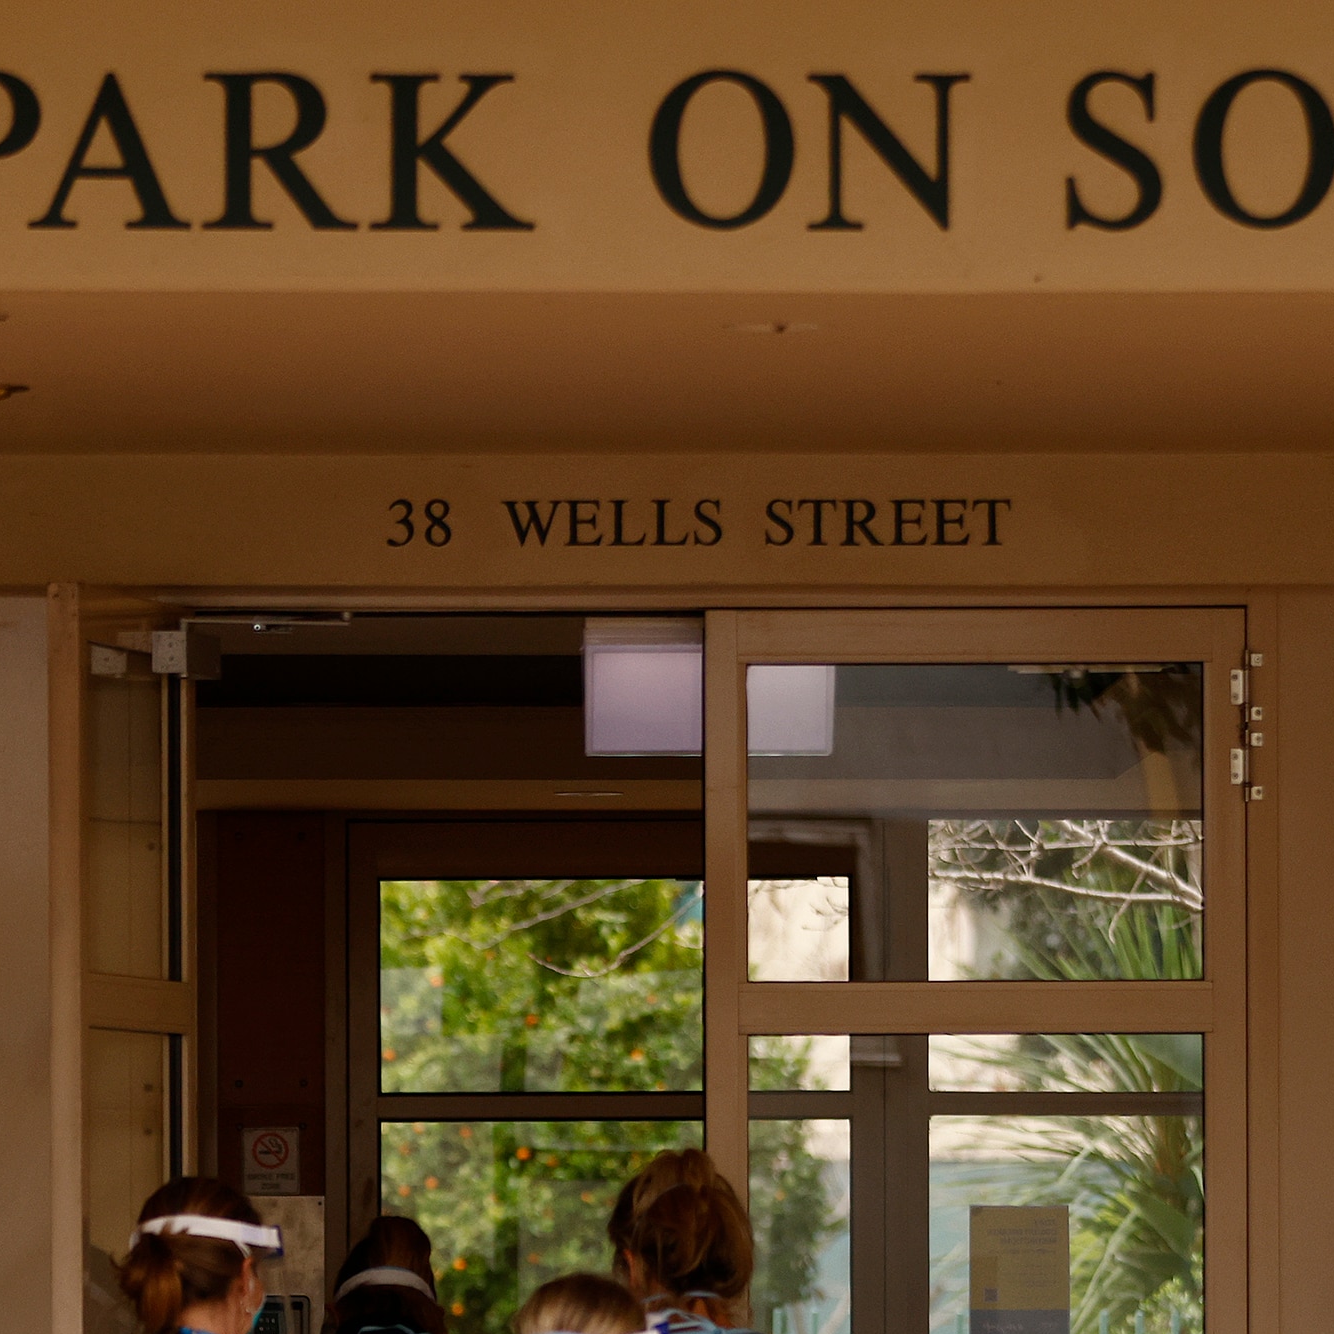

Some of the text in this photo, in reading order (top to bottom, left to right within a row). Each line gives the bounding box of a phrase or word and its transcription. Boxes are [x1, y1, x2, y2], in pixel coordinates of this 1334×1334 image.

[646, 66, 972, 231] ON
[387, 498, 1010, 547] 38 WELLS STREET
